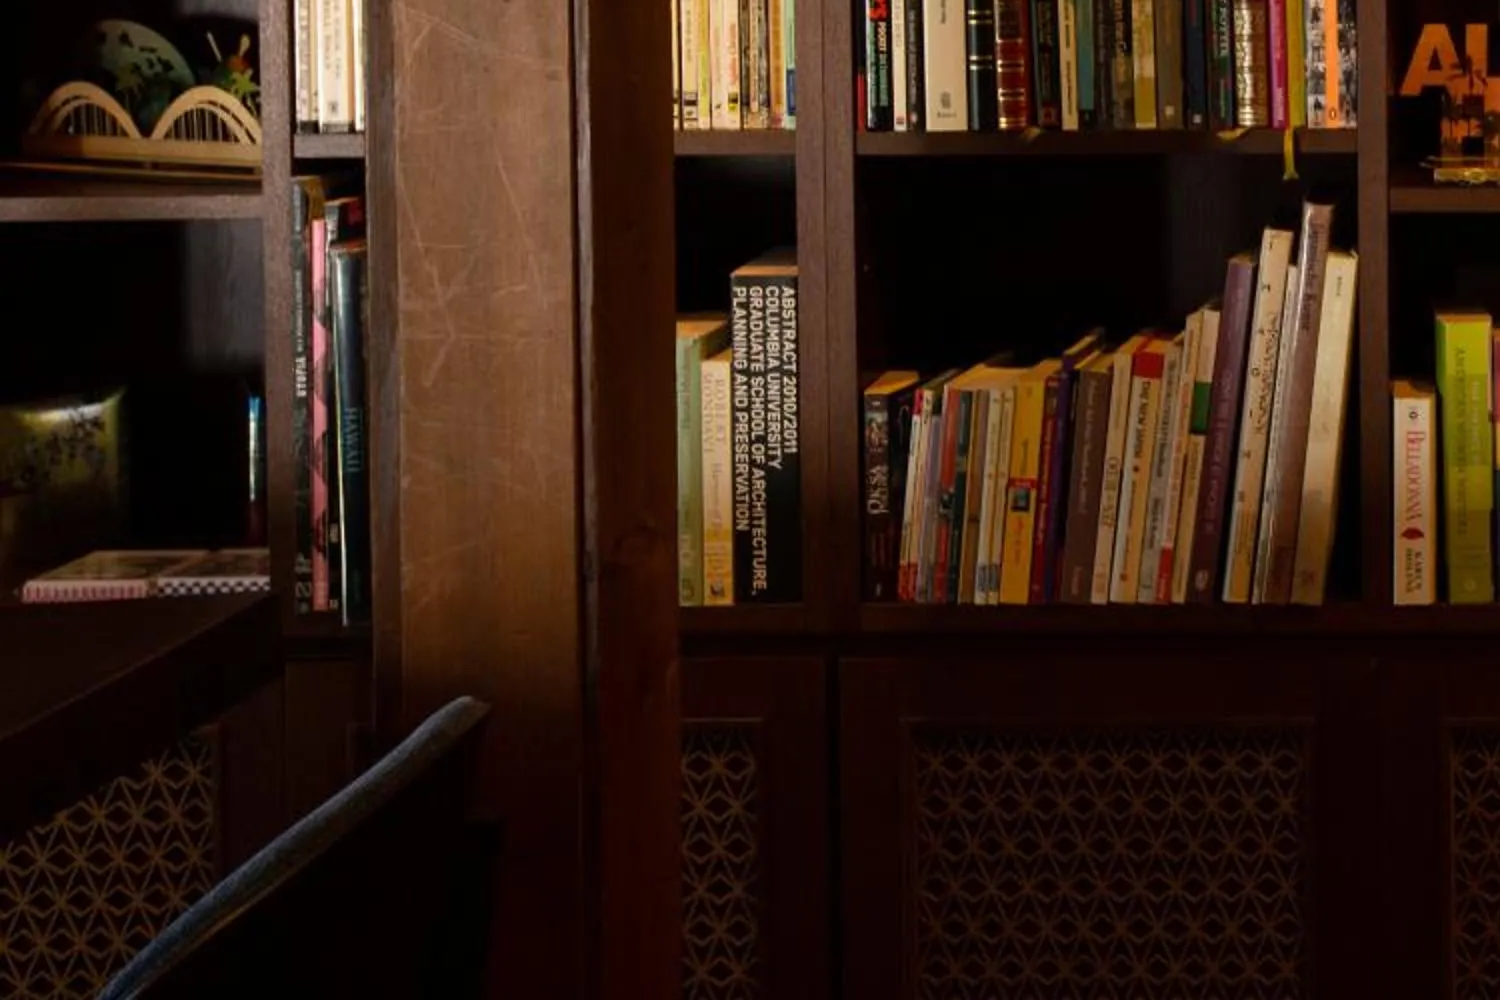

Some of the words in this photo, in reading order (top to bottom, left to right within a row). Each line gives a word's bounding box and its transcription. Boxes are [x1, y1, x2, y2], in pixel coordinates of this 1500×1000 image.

[733, 286, 748, 369] PLANNING
[749, 285, 765, 372] GRADUATE
[766, 285, 781, 367] COLUMBIA
[782, 285, 797, 371] ABSTRACT
[734, 373, 749, 408] AND
[750, 376, 765, 439] SCHOOL
[767, 373, 782, 469] UNIVERSITY
[783, 377, 798, 453] 2010/2011
[344, 407, 362, 474] HAWAII
[734, 411, 750, 531] PRESERVATION
[751, 443, 765, 465] OF
[1404, 431, 1424, 522] BELLADONNA
[751, 467, 767, 596] ARCHITECTURE,
